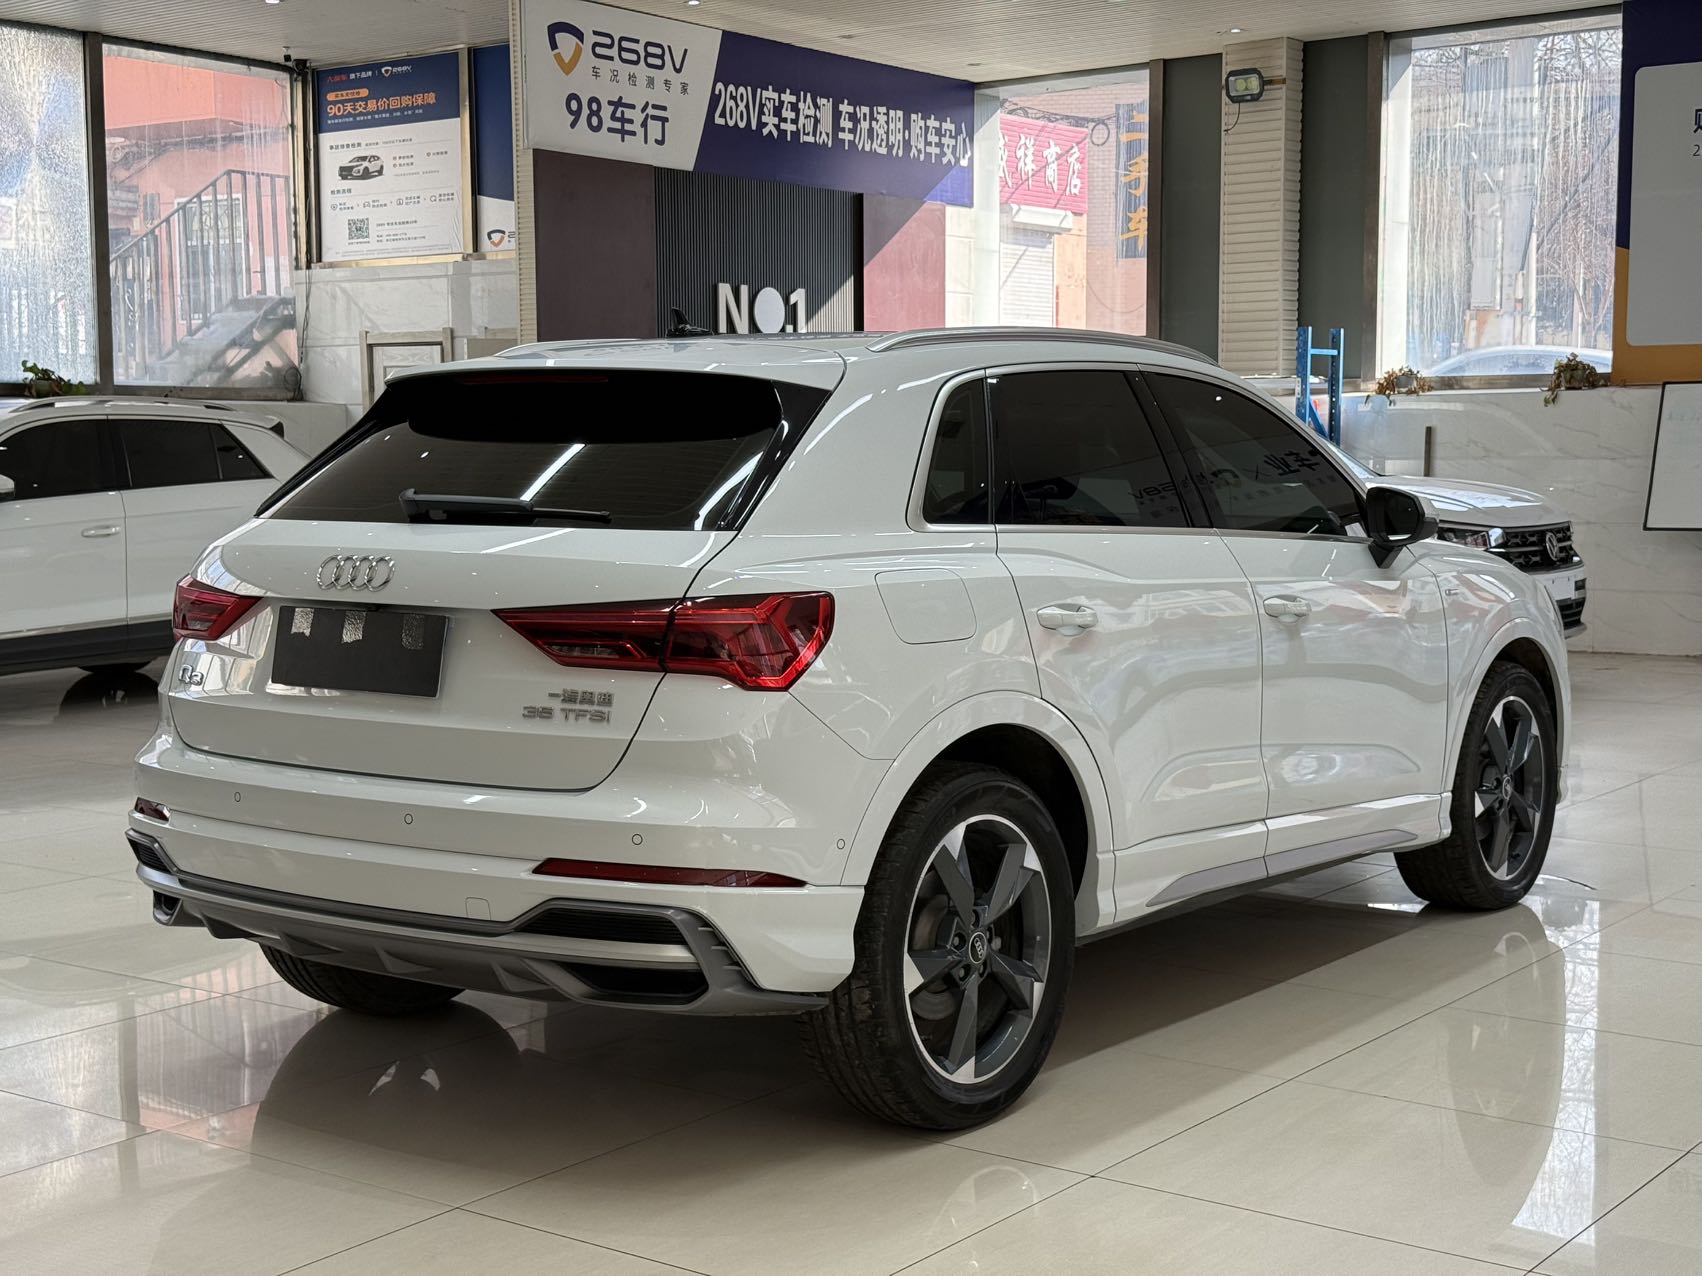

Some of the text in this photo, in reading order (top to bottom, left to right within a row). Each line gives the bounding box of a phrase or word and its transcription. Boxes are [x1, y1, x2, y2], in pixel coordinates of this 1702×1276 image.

[591, 29, 689, 75] 268V
[591, 65, 689, 96] 车况检测专家
[326, 92, 437, 117] 90天交易价回购保障
[565, 92, 670, 146] 98车行
[714, 81, 972, 167] 268V实车检测 车况透明·购车安心
[179, 664, 204, 686] Q3
[522, 705, 611, 724] 35 TFSI
